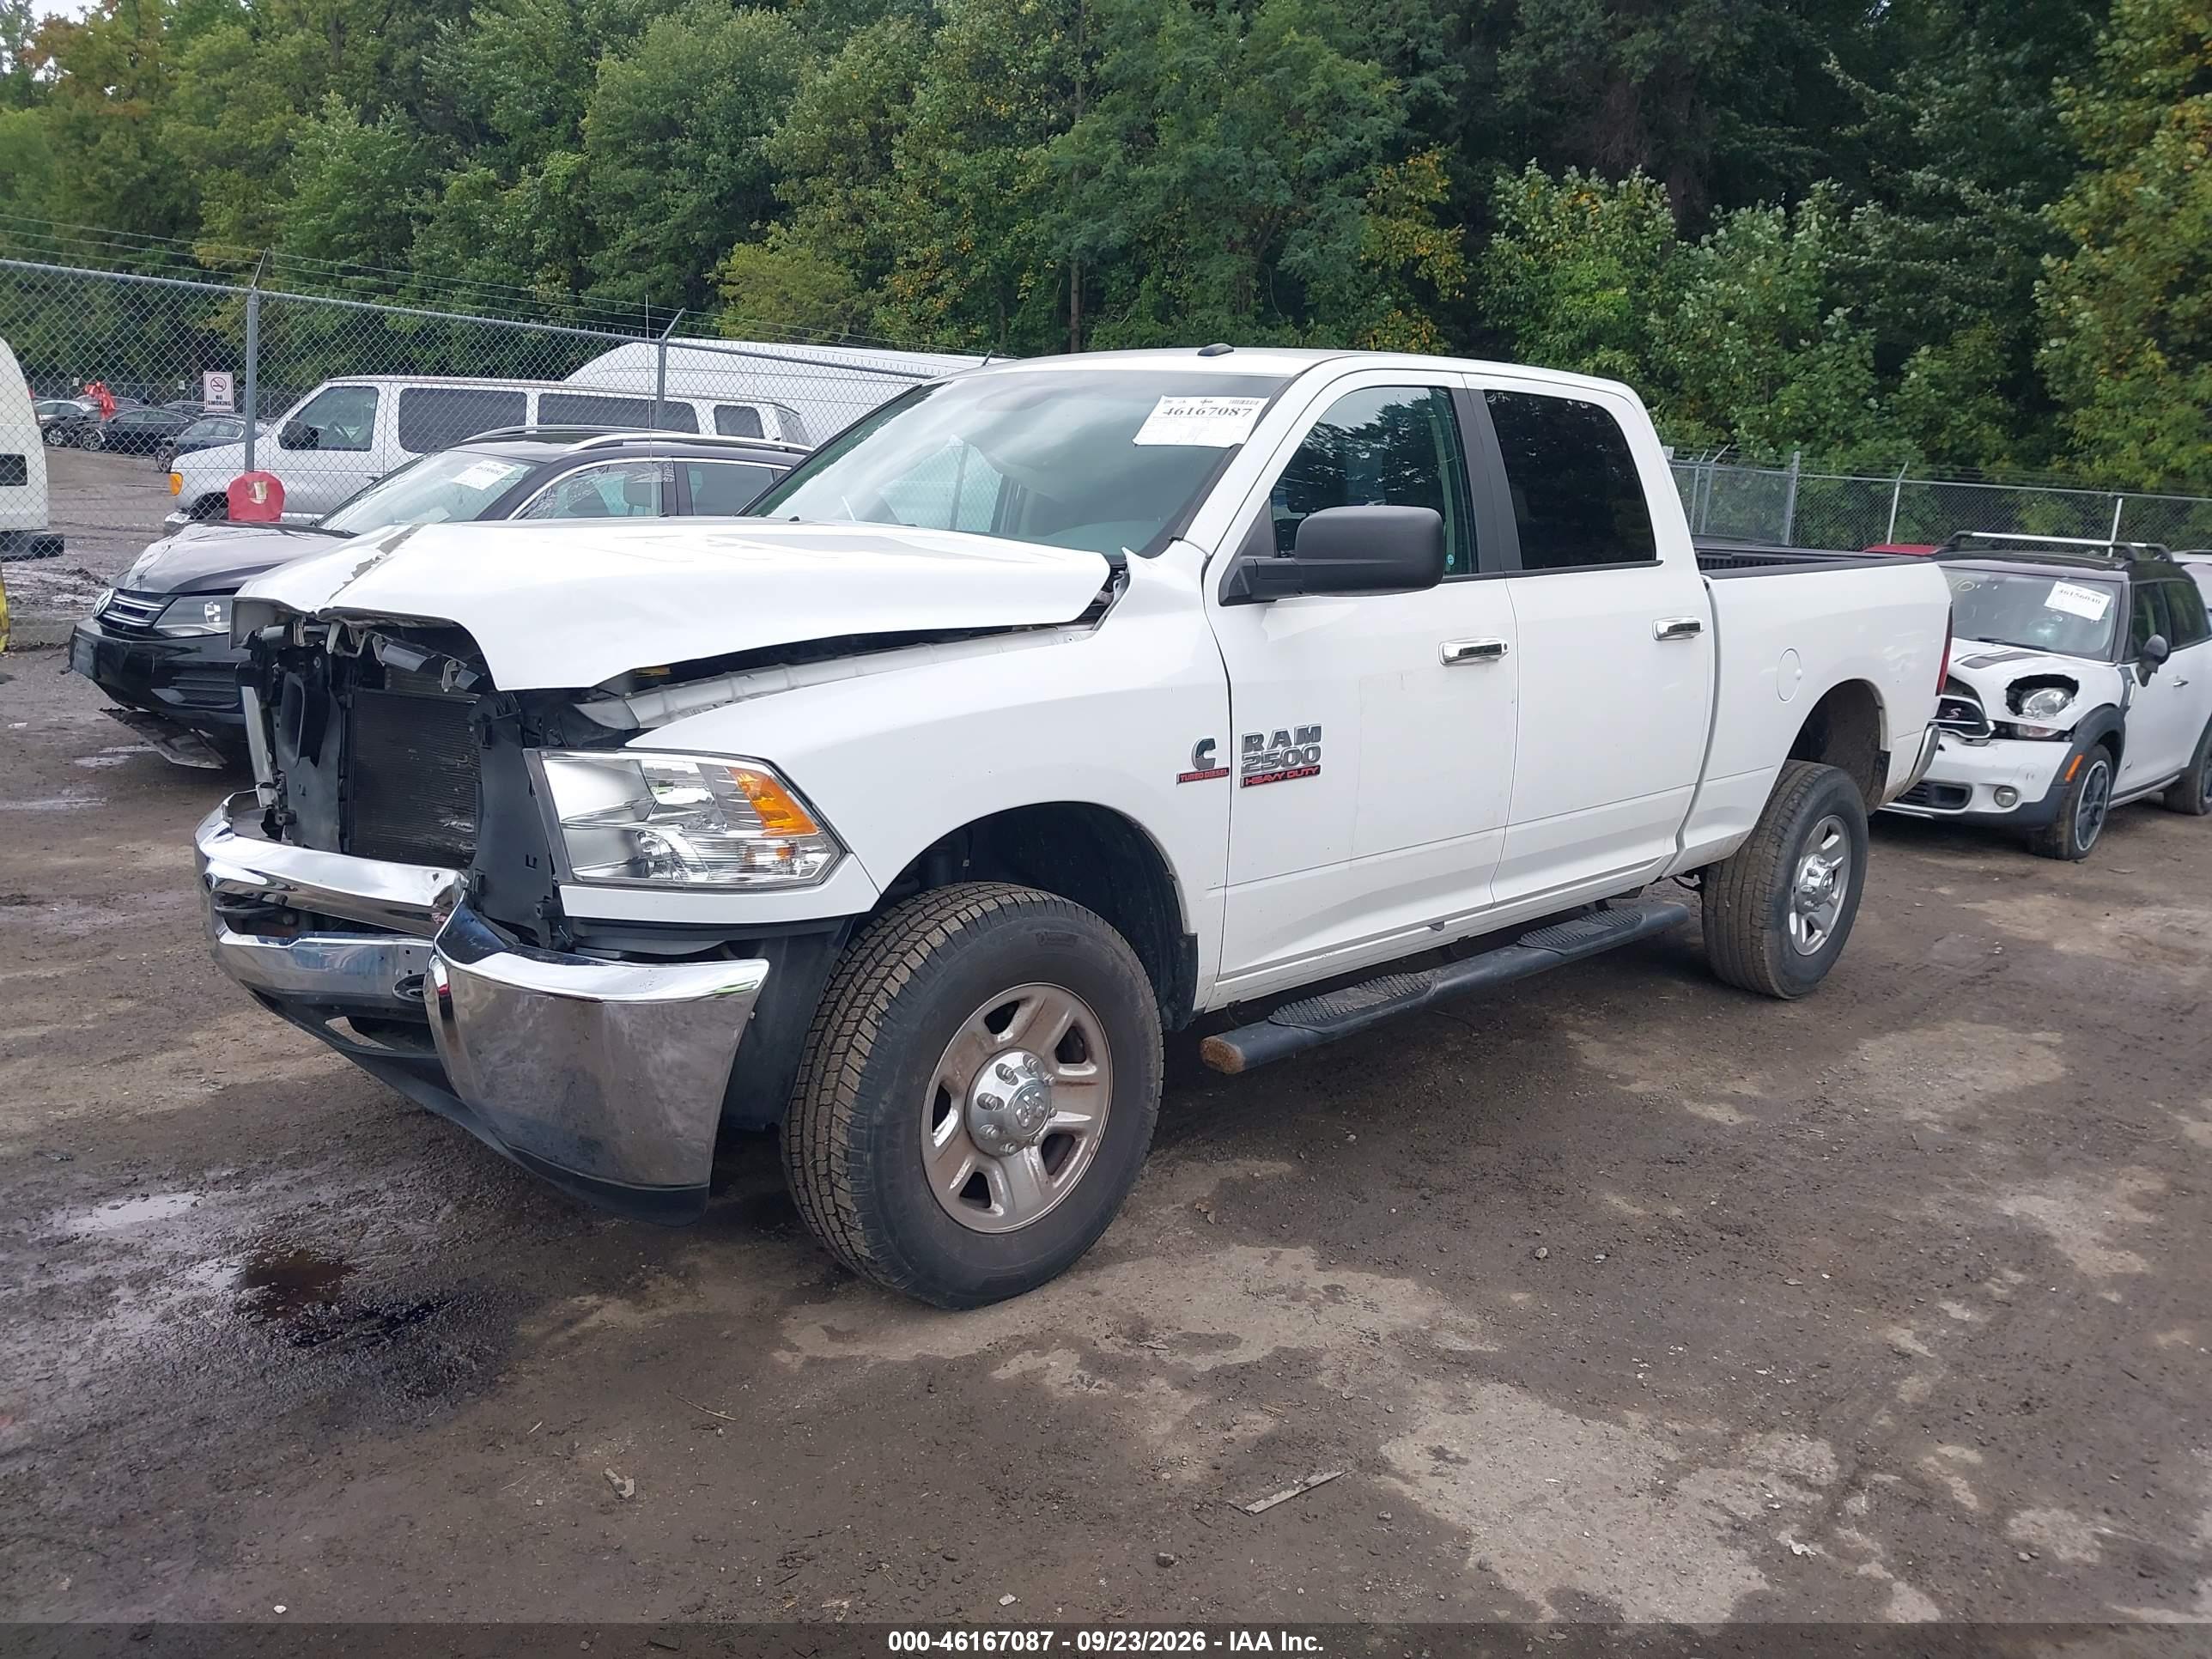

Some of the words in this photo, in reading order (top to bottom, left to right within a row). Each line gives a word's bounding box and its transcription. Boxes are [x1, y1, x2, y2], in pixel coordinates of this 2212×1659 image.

[1163, 407, 1253, 417] 46167087
[1241, 724, 1322, 754] RAM
[1241, 744, 1322, 775] 2500
[1245, 771, 1285, 786] HEAVY
[1286, 766, 1320, 779] DUTY
